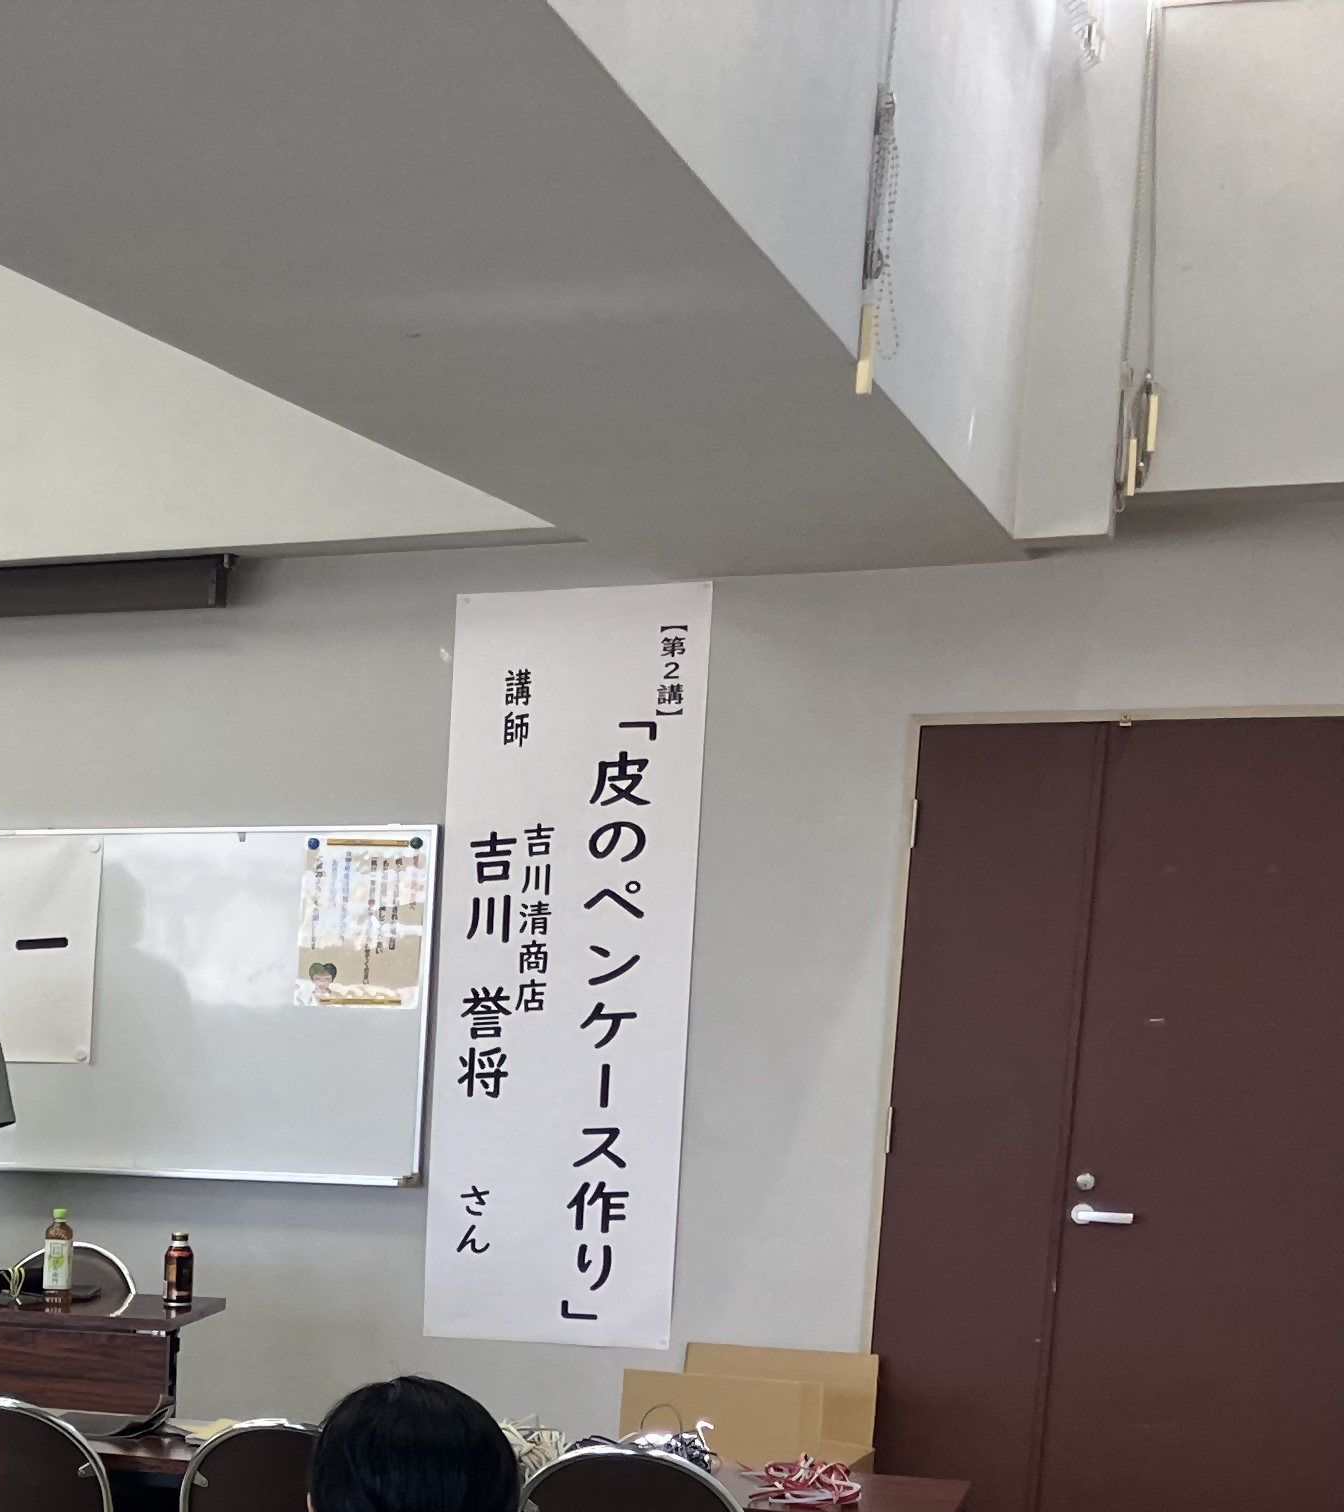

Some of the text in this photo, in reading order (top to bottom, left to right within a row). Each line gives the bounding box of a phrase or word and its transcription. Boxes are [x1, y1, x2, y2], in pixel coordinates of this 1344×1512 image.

[455, 668, 533, 1255] 講師 吉川 誉将 さん
[514, 822, 556, 1014] 吉川清商店
[559, 720, 659, 1322] 「皮のペンケース作り」
